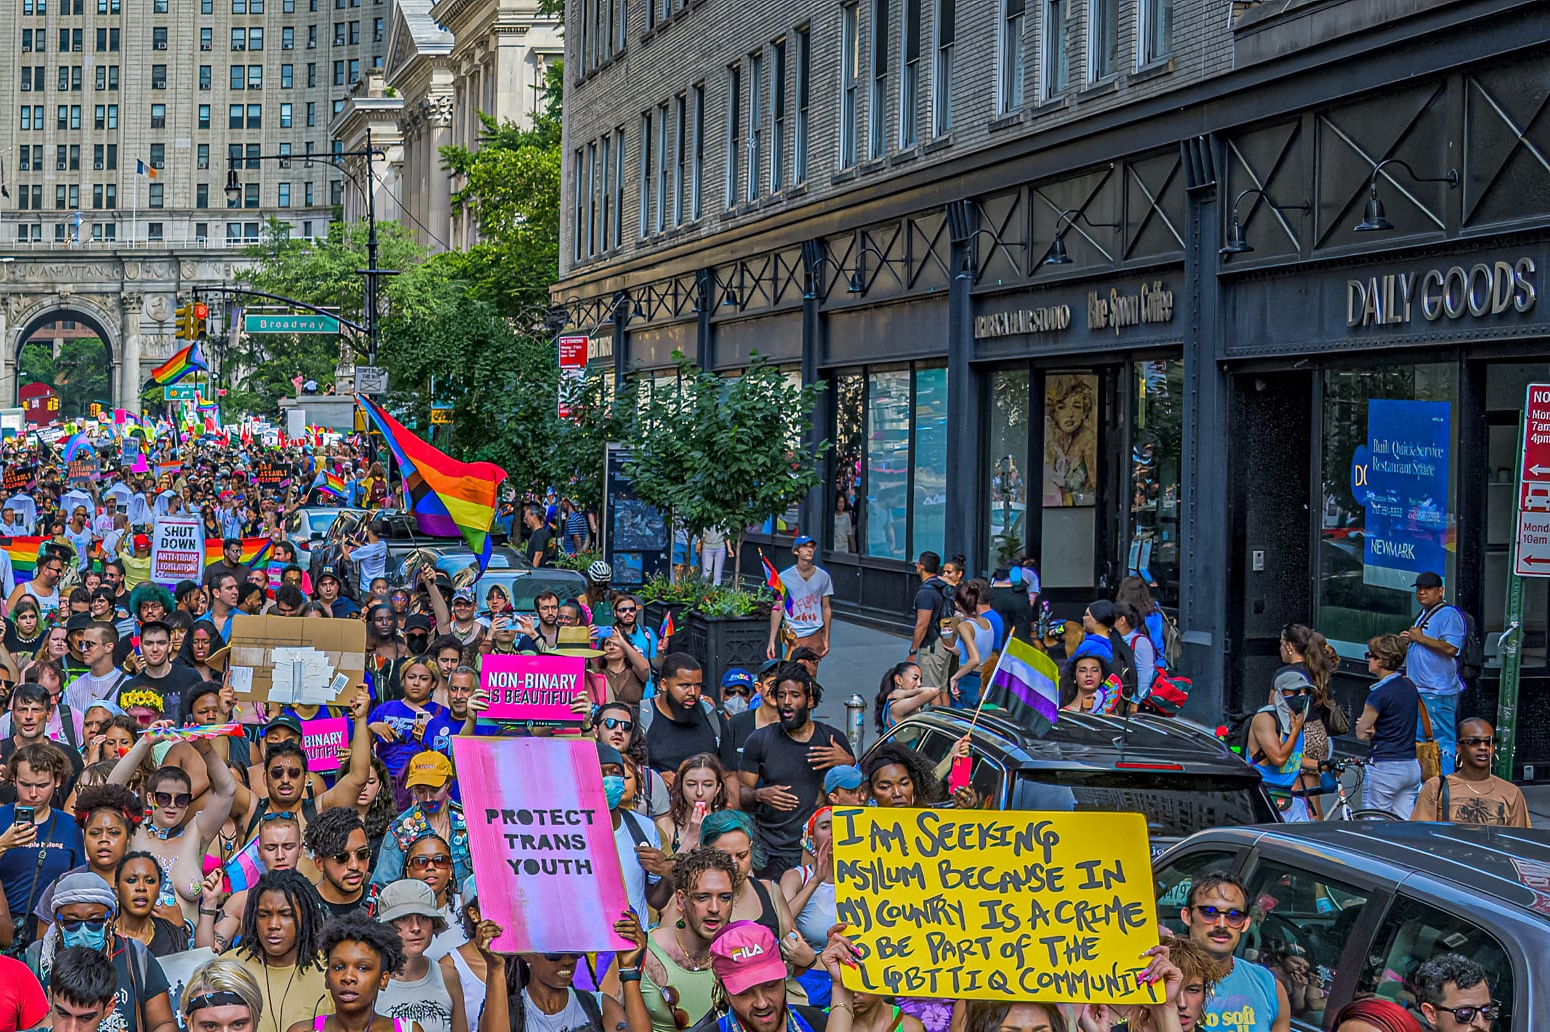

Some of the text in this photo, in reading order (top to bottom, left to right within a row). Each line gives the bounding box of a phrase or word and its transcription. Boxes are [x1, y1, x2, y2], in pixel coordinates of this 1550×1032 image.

[1347, 257, 1537, 327] DAILY GOODS
[1088, 280, 1173, 336] Blue Spoon Coffee
[260, 319, 324, 330] Broadway
[164, 526, 194, 538] SHUT
[1523, 534, 1547, 544] 10am
[161, 538, 196, 550] DOWN
[1370, 538, 1416, 560] NEWMARK
[158, 552, 198, 562] ANTI-TRANS
[488, 672, 577, 690] NON-BINARY
[505, 689, 575, 705] BEAUTIFUL
[485, 809, 595, 825] PROTECT
[503, 834, 587, 850] TRANS
[833, 808, 1060, 863] I AM SEEKING
[41, 841, 64, 850] blong
[506, 858, 593, 875] YOUTH
[837, 857, 1126, 895] ASYLUM BECAUSE IN
[837, 893, 1148, 935] MY COUNTRY IS A CRIME
[731, 943, 764, 961] FILA
[875, 934, 915, 960] BE
[925, 931, 993, 965] PART
[1039, 935, 1101, 965] THE
[1221, 1004, 1256, 1026] soft
